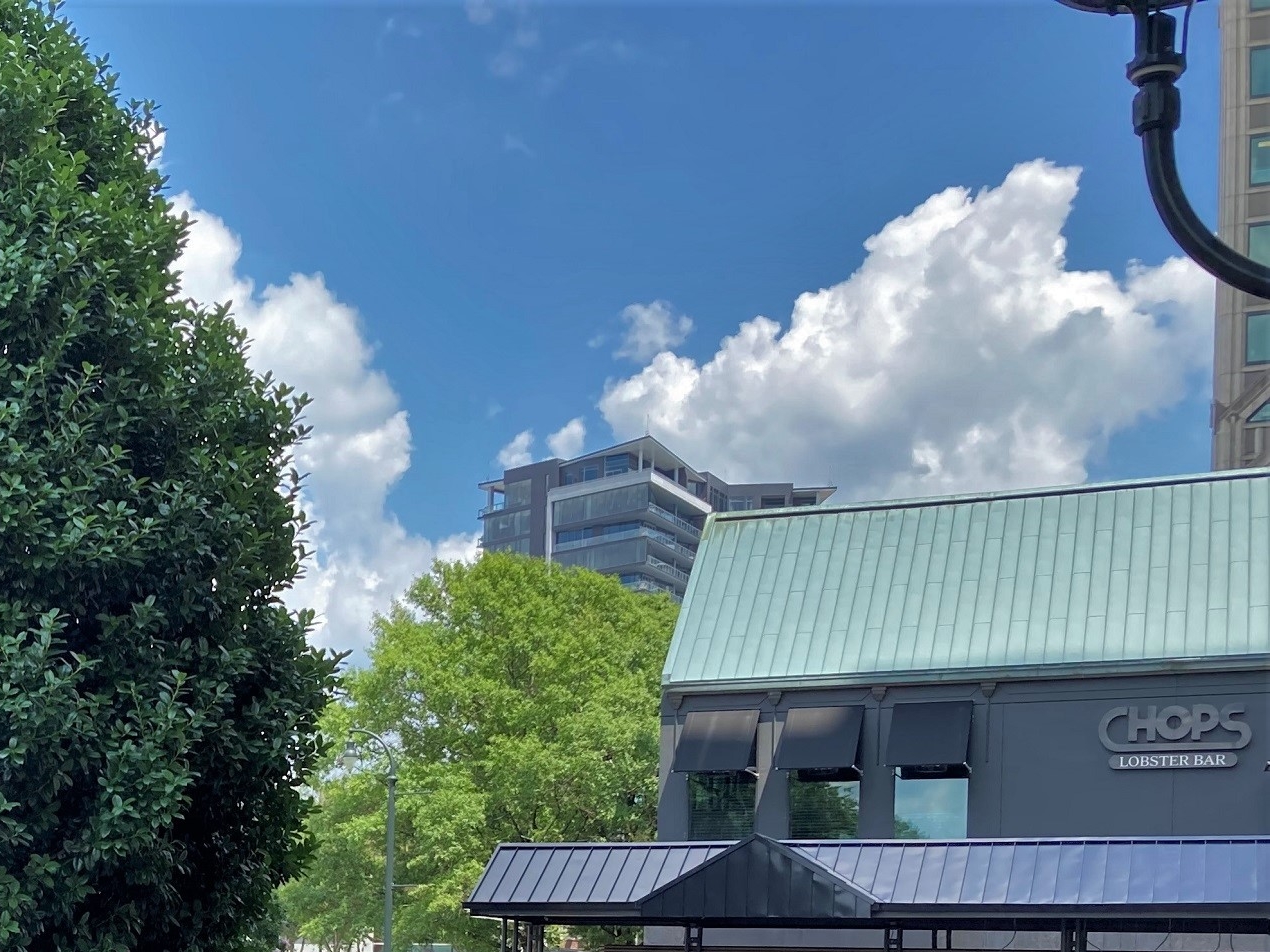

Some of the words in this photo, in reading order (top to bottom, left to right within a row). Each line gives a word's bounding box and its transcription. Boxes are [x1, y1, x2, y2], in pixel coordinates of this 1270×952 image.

[1098, 703, 1252, 752] CHOPS
[1119, 755, 1189, 768] LOBSTER
[1194, 754, 1226, 766] BAR
